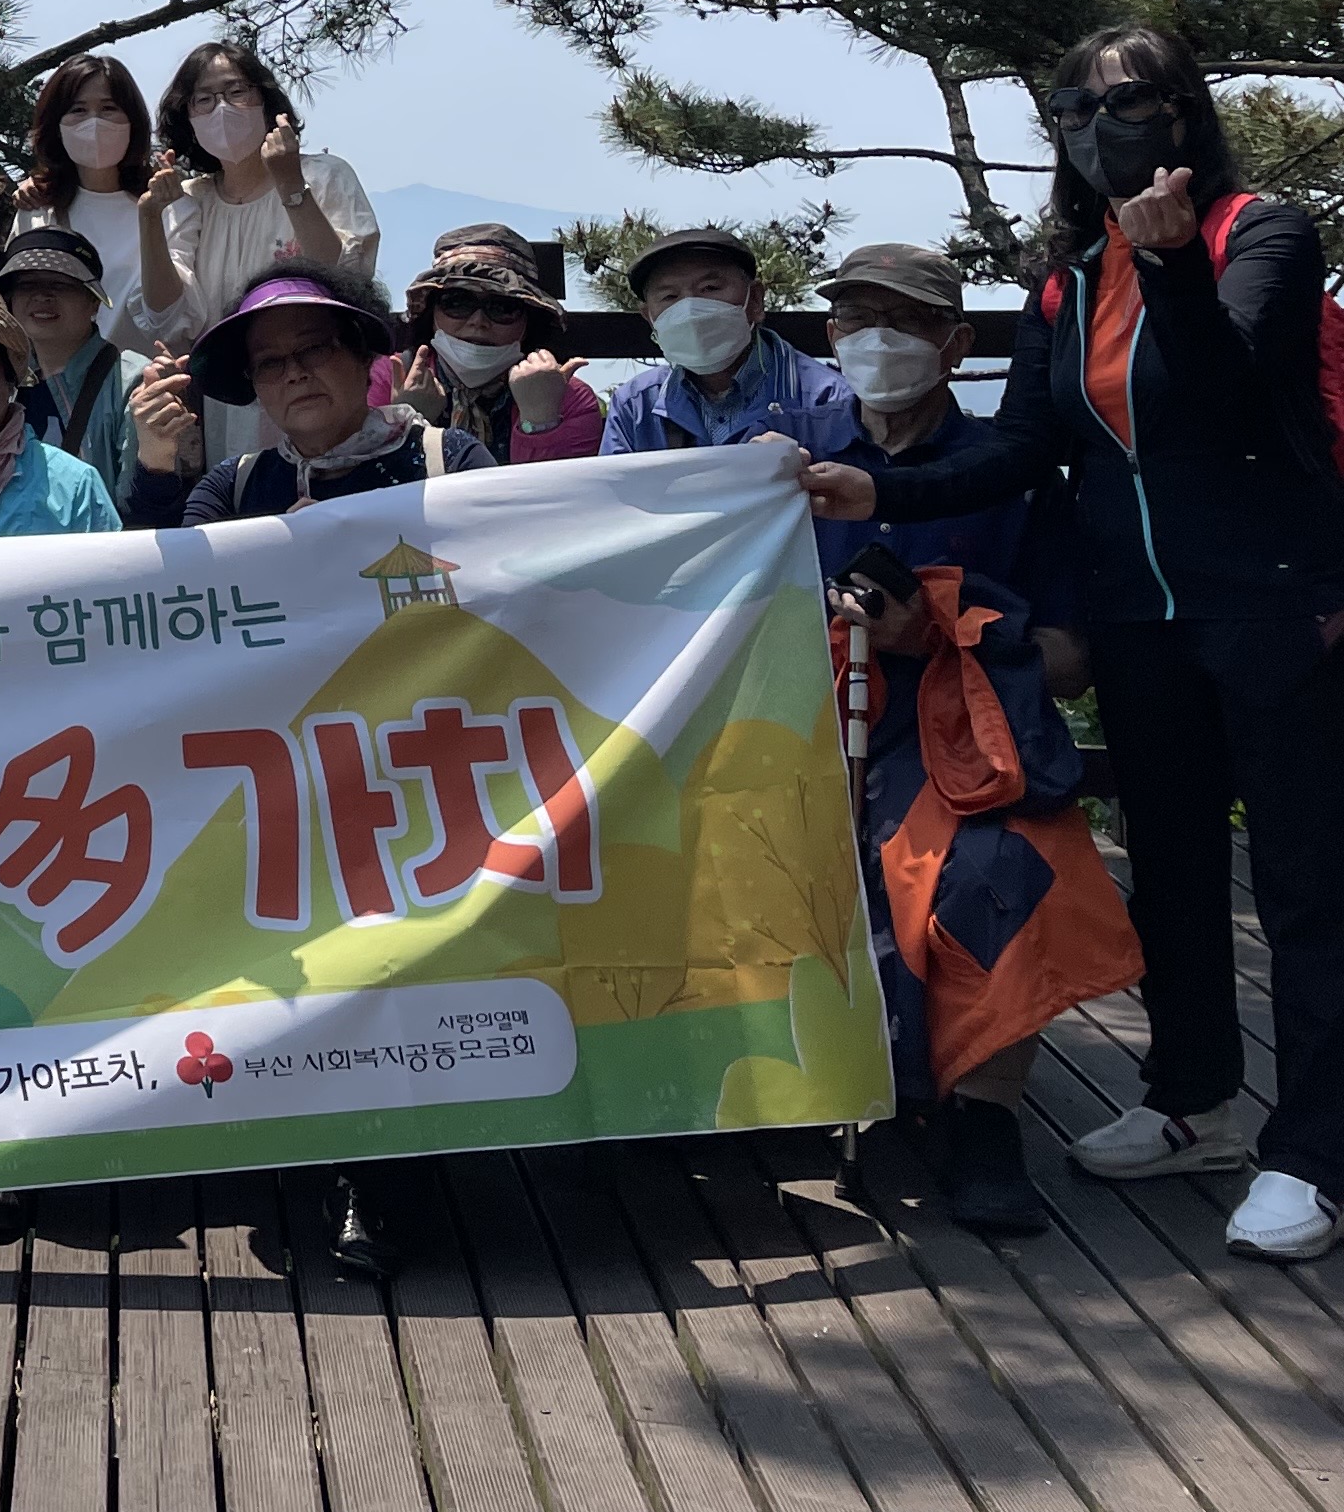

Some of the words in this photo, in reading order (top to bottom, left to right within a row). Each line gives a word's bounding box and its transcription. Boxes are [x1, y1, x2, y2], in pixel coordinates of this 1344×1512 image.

[26, 584, 287, 667] 함께하는
[183, 702, 595, 922] 가치
[438, 1010, 529, 1035] 사랑의열매
[243, 1054, 294, 1079] 부산
[302, 1033, 536, 1074] 사회복지공동모금회
